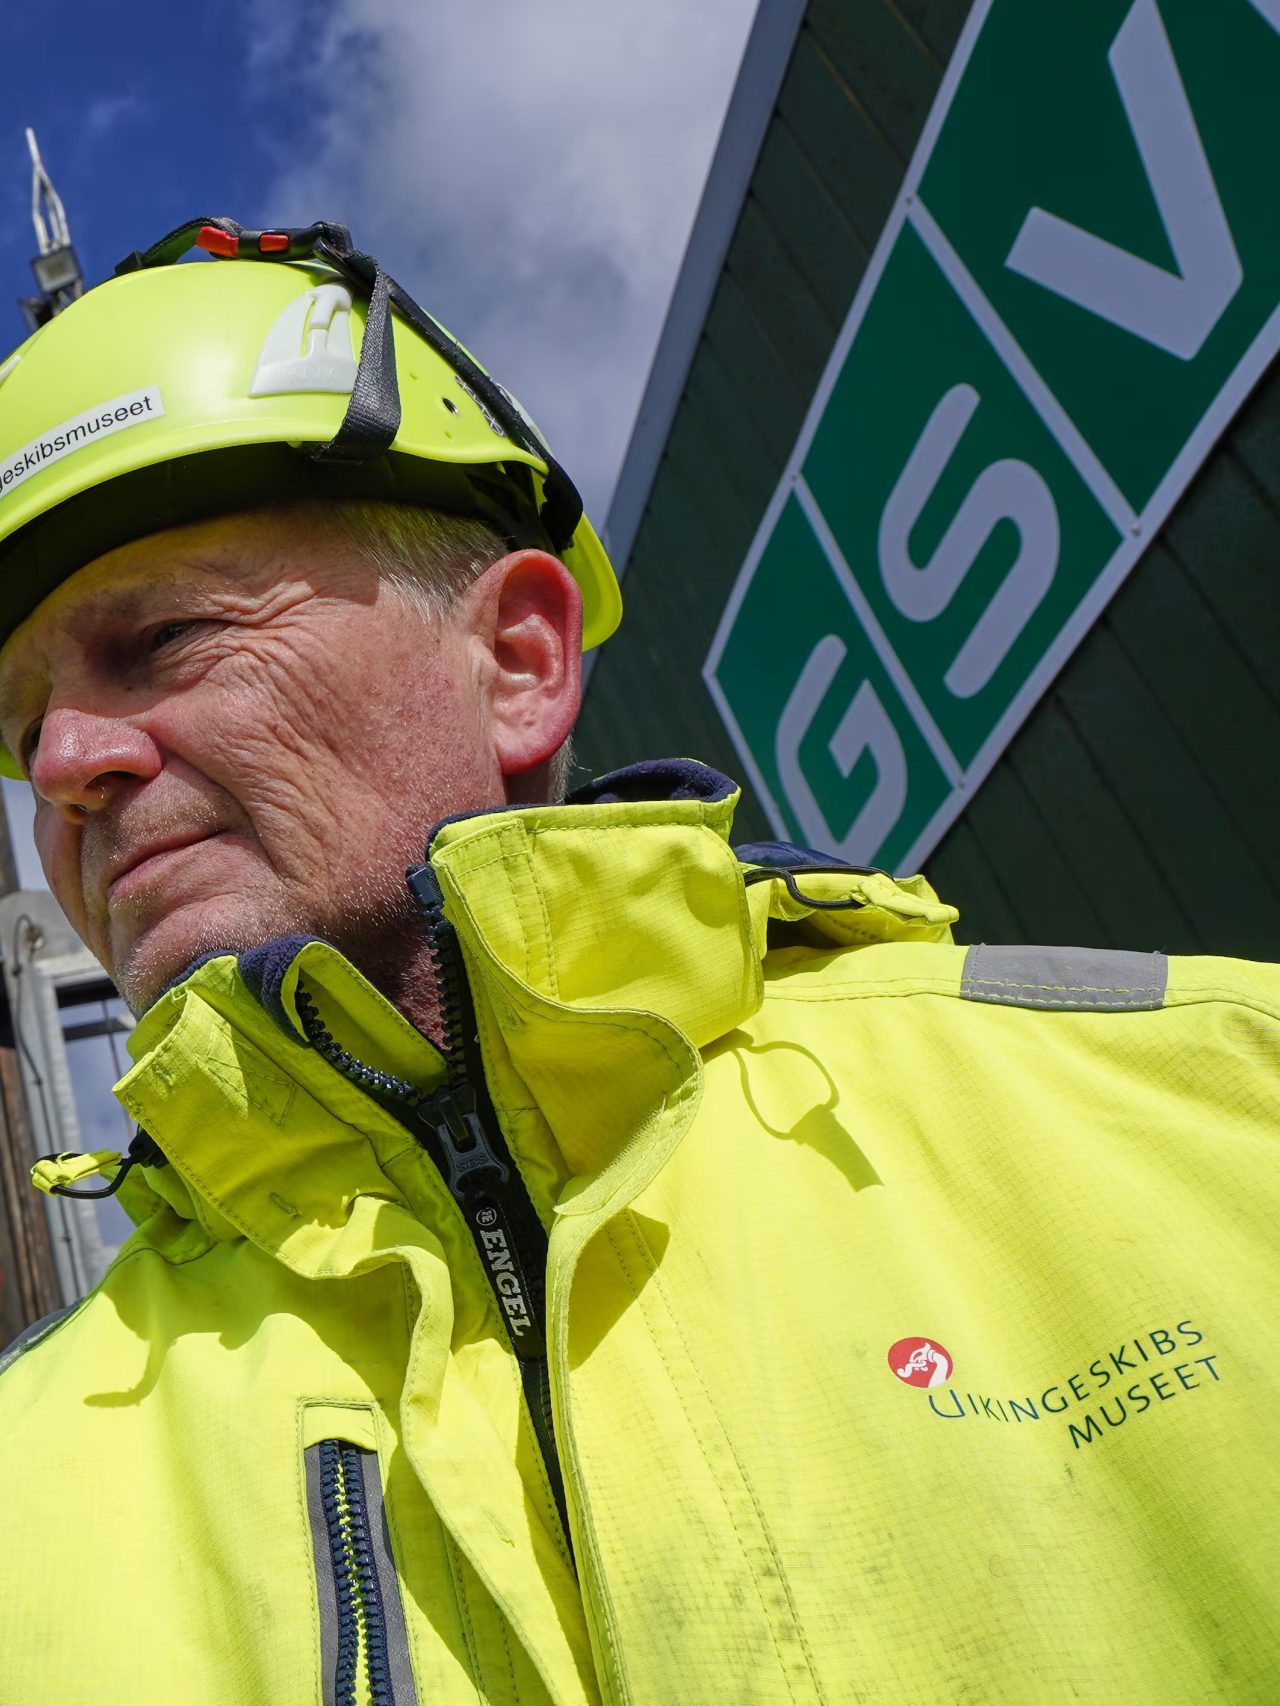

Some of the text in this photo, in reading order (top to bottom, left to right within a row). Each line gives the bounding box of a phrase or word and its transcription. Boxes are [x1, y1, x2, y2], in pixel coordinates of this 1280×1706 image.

[775, 0, 1243, 866] GSV
[480, 1229, 531, 1336] ENGEL
[1068, 1355, 1221, 1449] MUSEET
